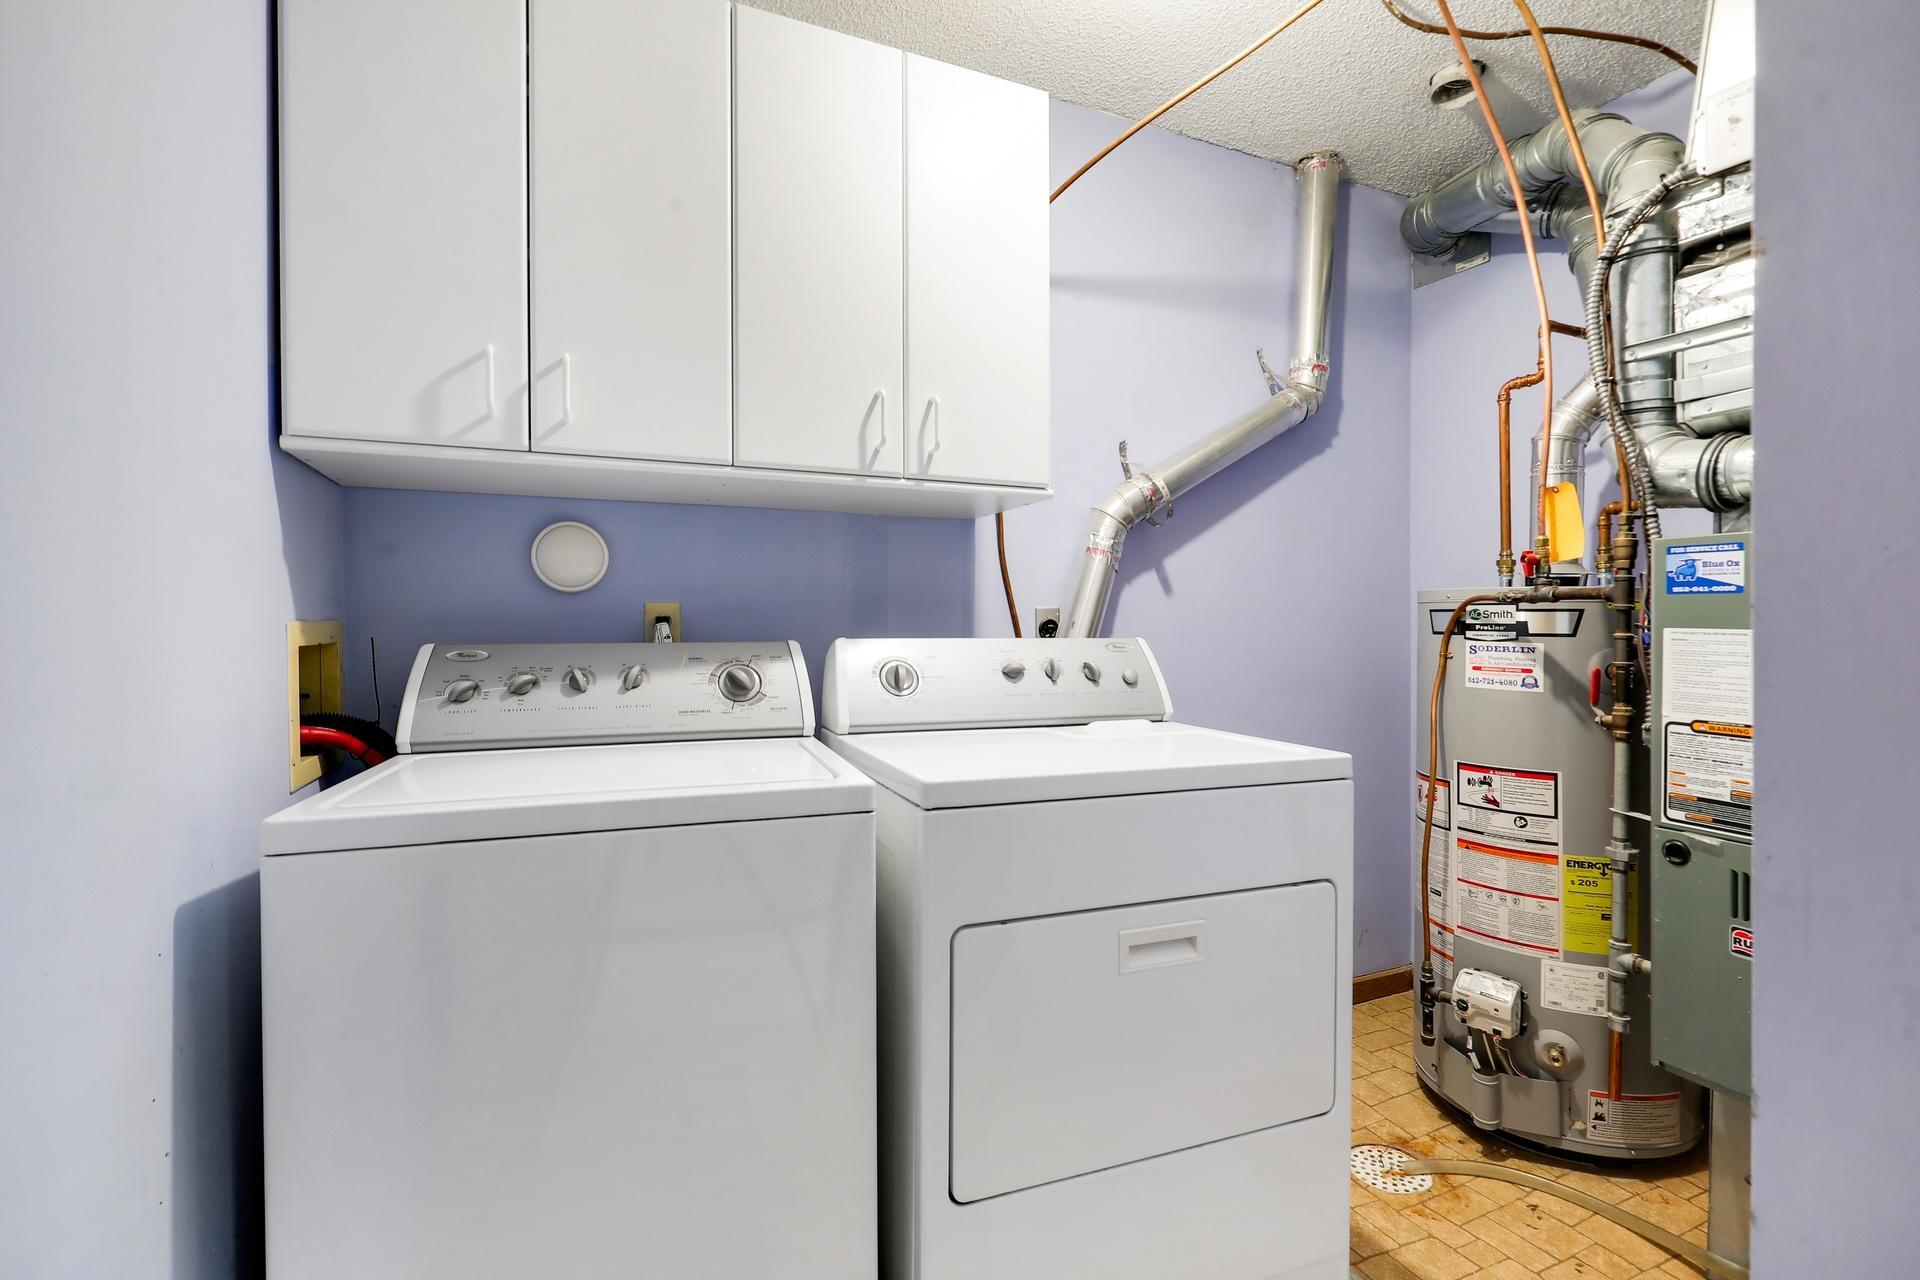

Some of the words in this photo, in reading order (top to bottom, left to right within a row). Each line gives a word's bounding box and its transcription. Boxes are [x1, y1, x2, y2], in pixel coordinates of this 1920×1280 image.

[1726, 559, 1741, 567] Ox
[1482, 609, 1513, 619] Smith
[1469, 645, 1536, 655] SODERLIN
[1467, 676, 1518, 686] 612-721-4080
[1708, 725, 1750, 735] WARNING
[1578, 879, 1599, 887] 205
